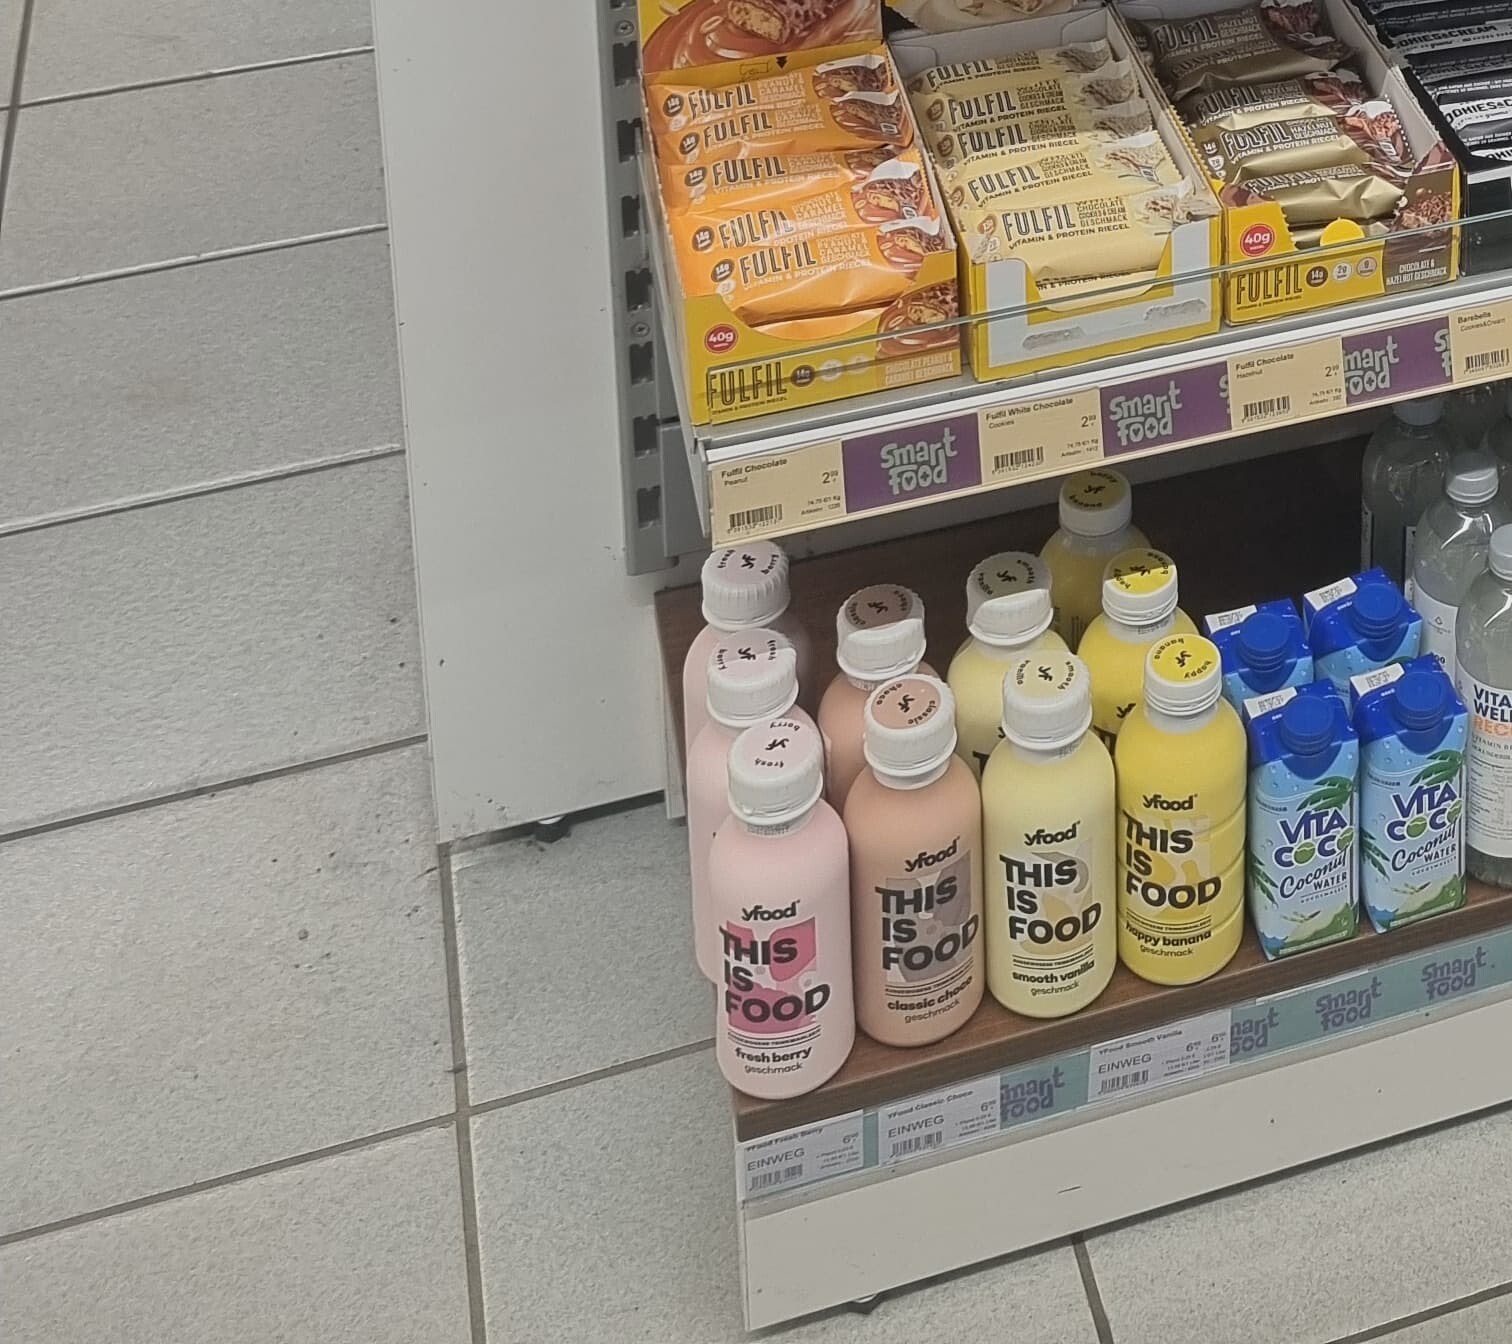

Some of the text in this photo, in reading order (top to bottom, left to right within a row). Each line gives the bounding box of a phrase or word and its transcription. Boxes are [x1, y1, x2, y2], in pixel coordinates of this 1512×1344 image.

[1001, 203, 1076, 242] FULFIL
[1244, 229, 1271, 246] 40g
[1236, 263, 1303, 305] FULFIL
[706, 361, 788, 409] FULFIL
[1143, 794, 1194, 811] yfood
[1024, 823, 1077, 846] yfood
[1280, 809, 1348, 845] VITA
[1313, 872, 1348, 891] WATER
[719, 925, 798, 965] THIS
[1125, 920, 1212, 947] happy banana
[724, 959, 754, 993] IS
[725, 983, 831, 1024] FOOD
[888, 975, 973, 1011] classic choco
[735, 1046, 812, 1064] fresh berry
[1099, 1052, 1152, 1075] EINWEG
[747, 1147, 806, 1172] EINWEG
